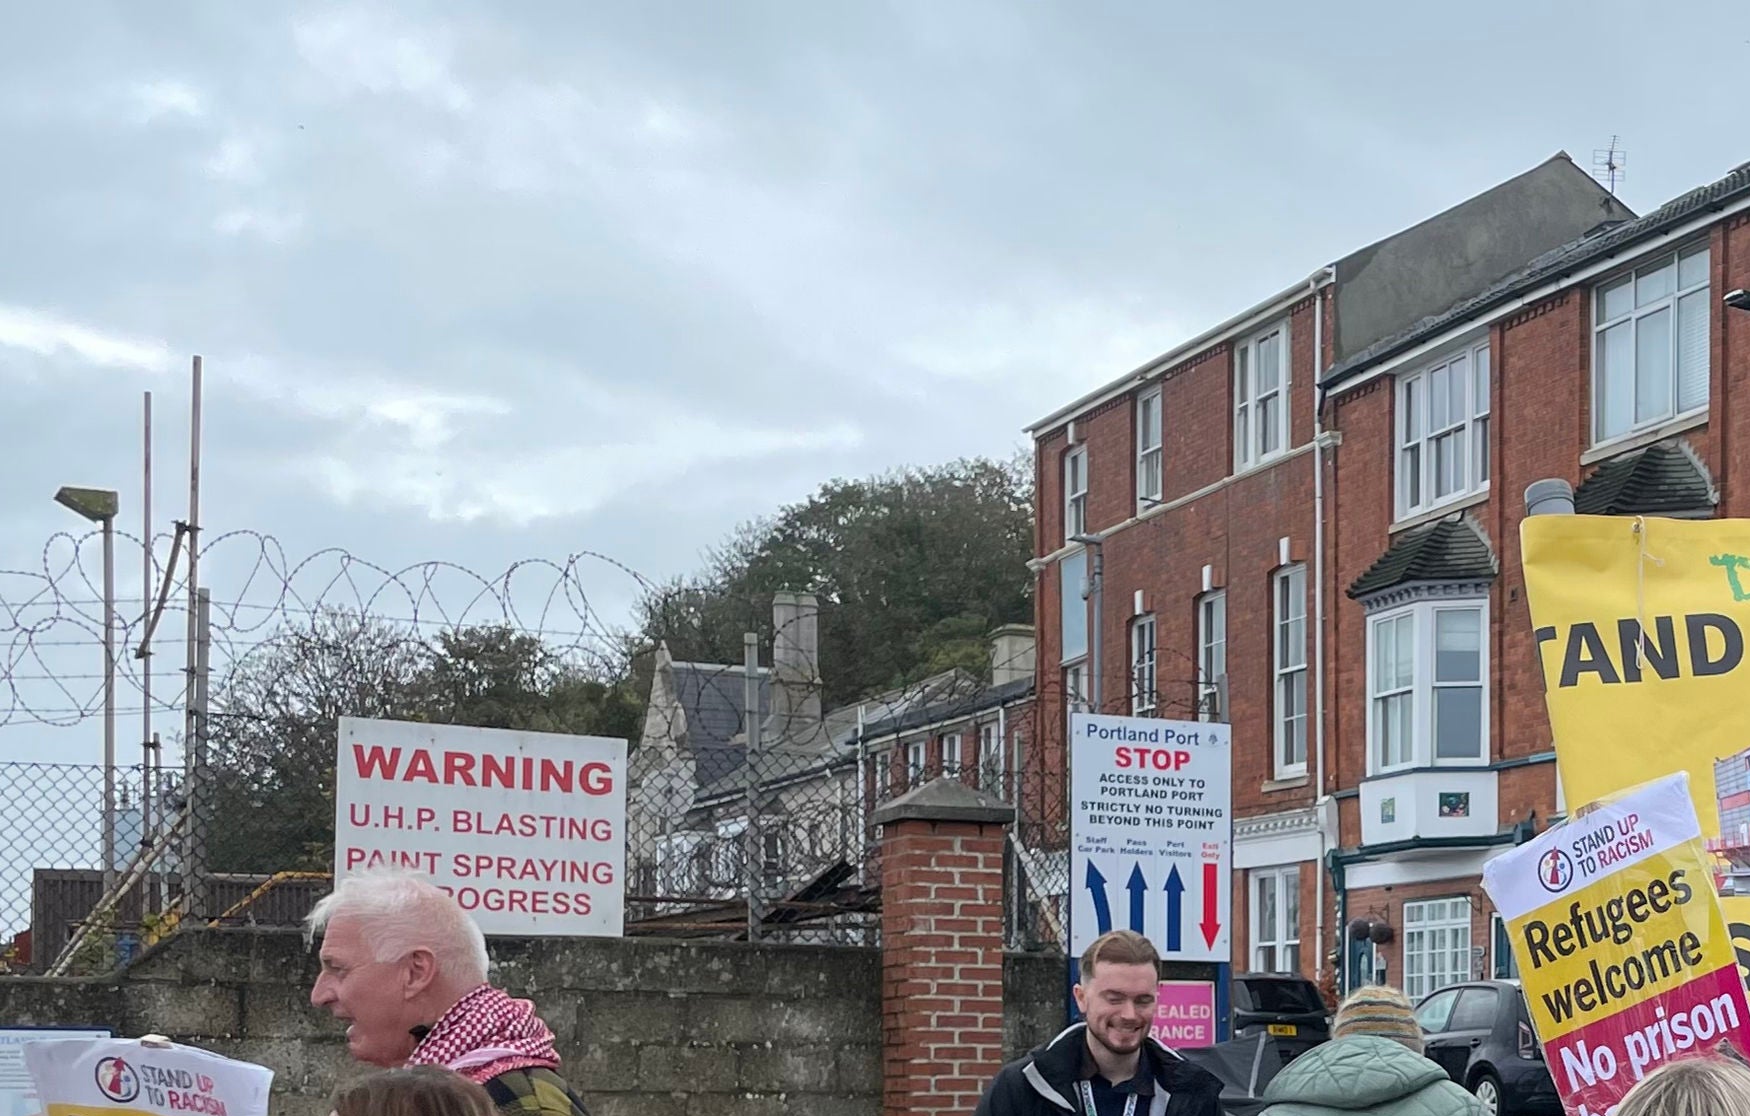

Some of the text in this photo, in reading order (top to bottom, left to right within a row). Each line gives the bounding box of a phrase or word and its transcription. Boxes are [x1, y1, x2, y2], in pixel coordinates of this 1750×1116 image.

[1087, 723, 1200, 745] Portland Port
[352, 744, 613, 796] WARNING
[1115, 746, 1190, 771] STOP
[1100, 773, 1205, 789] ACCESS ONLY TO
[1101, 786, 1204, 801] PORTLAND PORT
[1081, 801, 1223, 818] STRICTLY NO TURNING
[1090, 814, 1215, 830] BEYOND THIS POINT
[350, 803, 613, 842] U.H.P. BLASTING
[1086, 836, 1107, 844] Staff
[1127, 839, 1147, 847] Pass
[1572, 813, 1640, 860] STAND UP
[1120, 847, 1153, 856] Holders
[1159, 850, 1192, 858] Visitors
[1201, 851, 1220, 860] Only
[1577, 828, 1655, 878] TO RACISM
[347, 848, 614, 885] PAINT SPRAYING
[437, 886, 592, 916] OGRESS
[1522, 868, 1694, 970] Refugees
[1542, 929, 1704, 1025] welcome
[1154, 1004, 1211, 1019] EALED
[1150, 1024, 1205, 1040] RANCE
[1559, 992, 1741, 1095] No prison
[143, 1064, 214, 1093] STAND UP
[145, 1085, 165, 1106] TO
